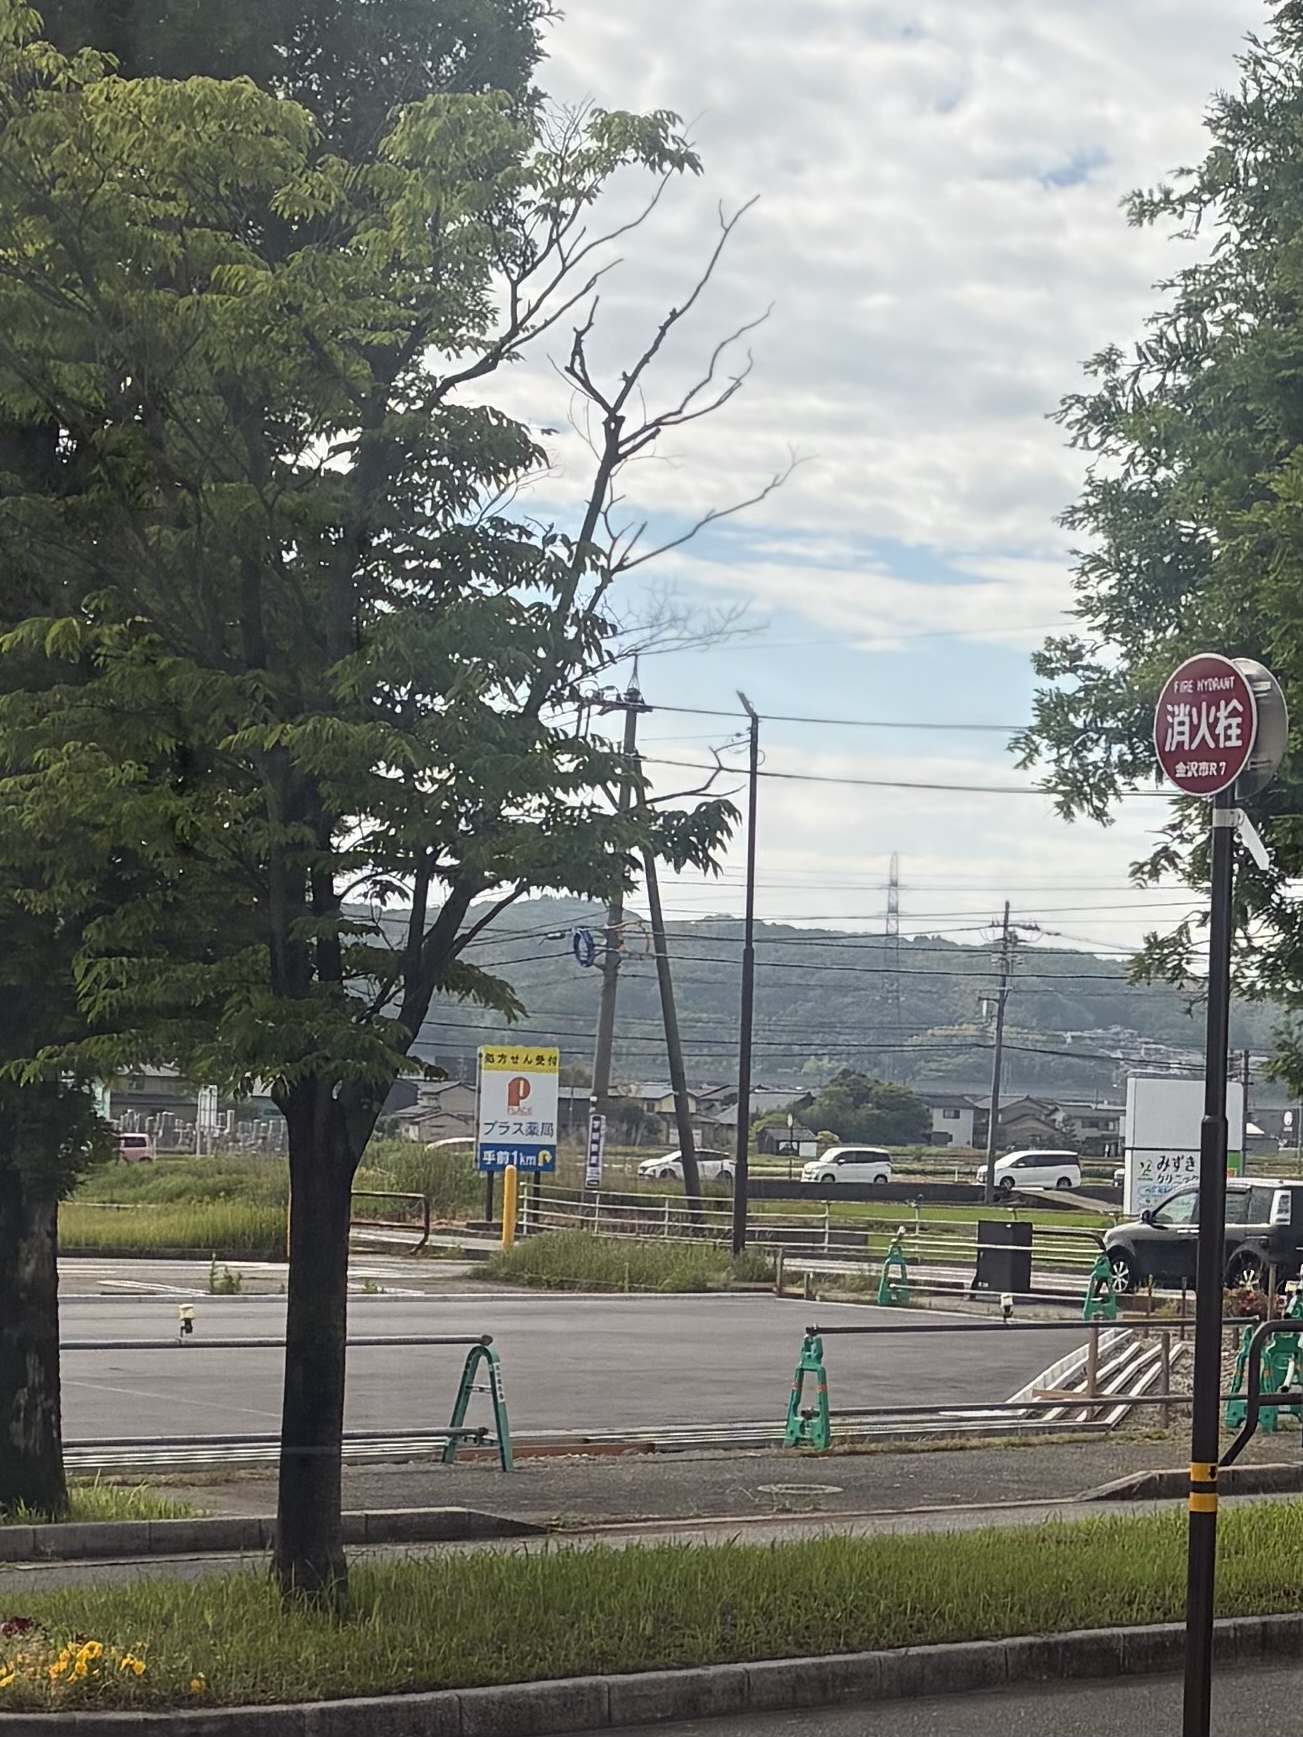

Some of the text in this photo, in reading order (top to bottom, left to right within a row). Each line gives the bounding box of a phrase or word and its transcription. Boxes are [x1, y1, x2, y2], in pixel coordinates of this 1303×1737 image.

[1174, 676, 1235, 693] FIRE HYDRANT
[1164, 698, 1244, 752] 消火栓
[485, 1053, 558, 1066] 処方せん受付
[483, 1120, 554, 1138] プラス薬局
[1157, 1155, 1195, 1173] みずき
